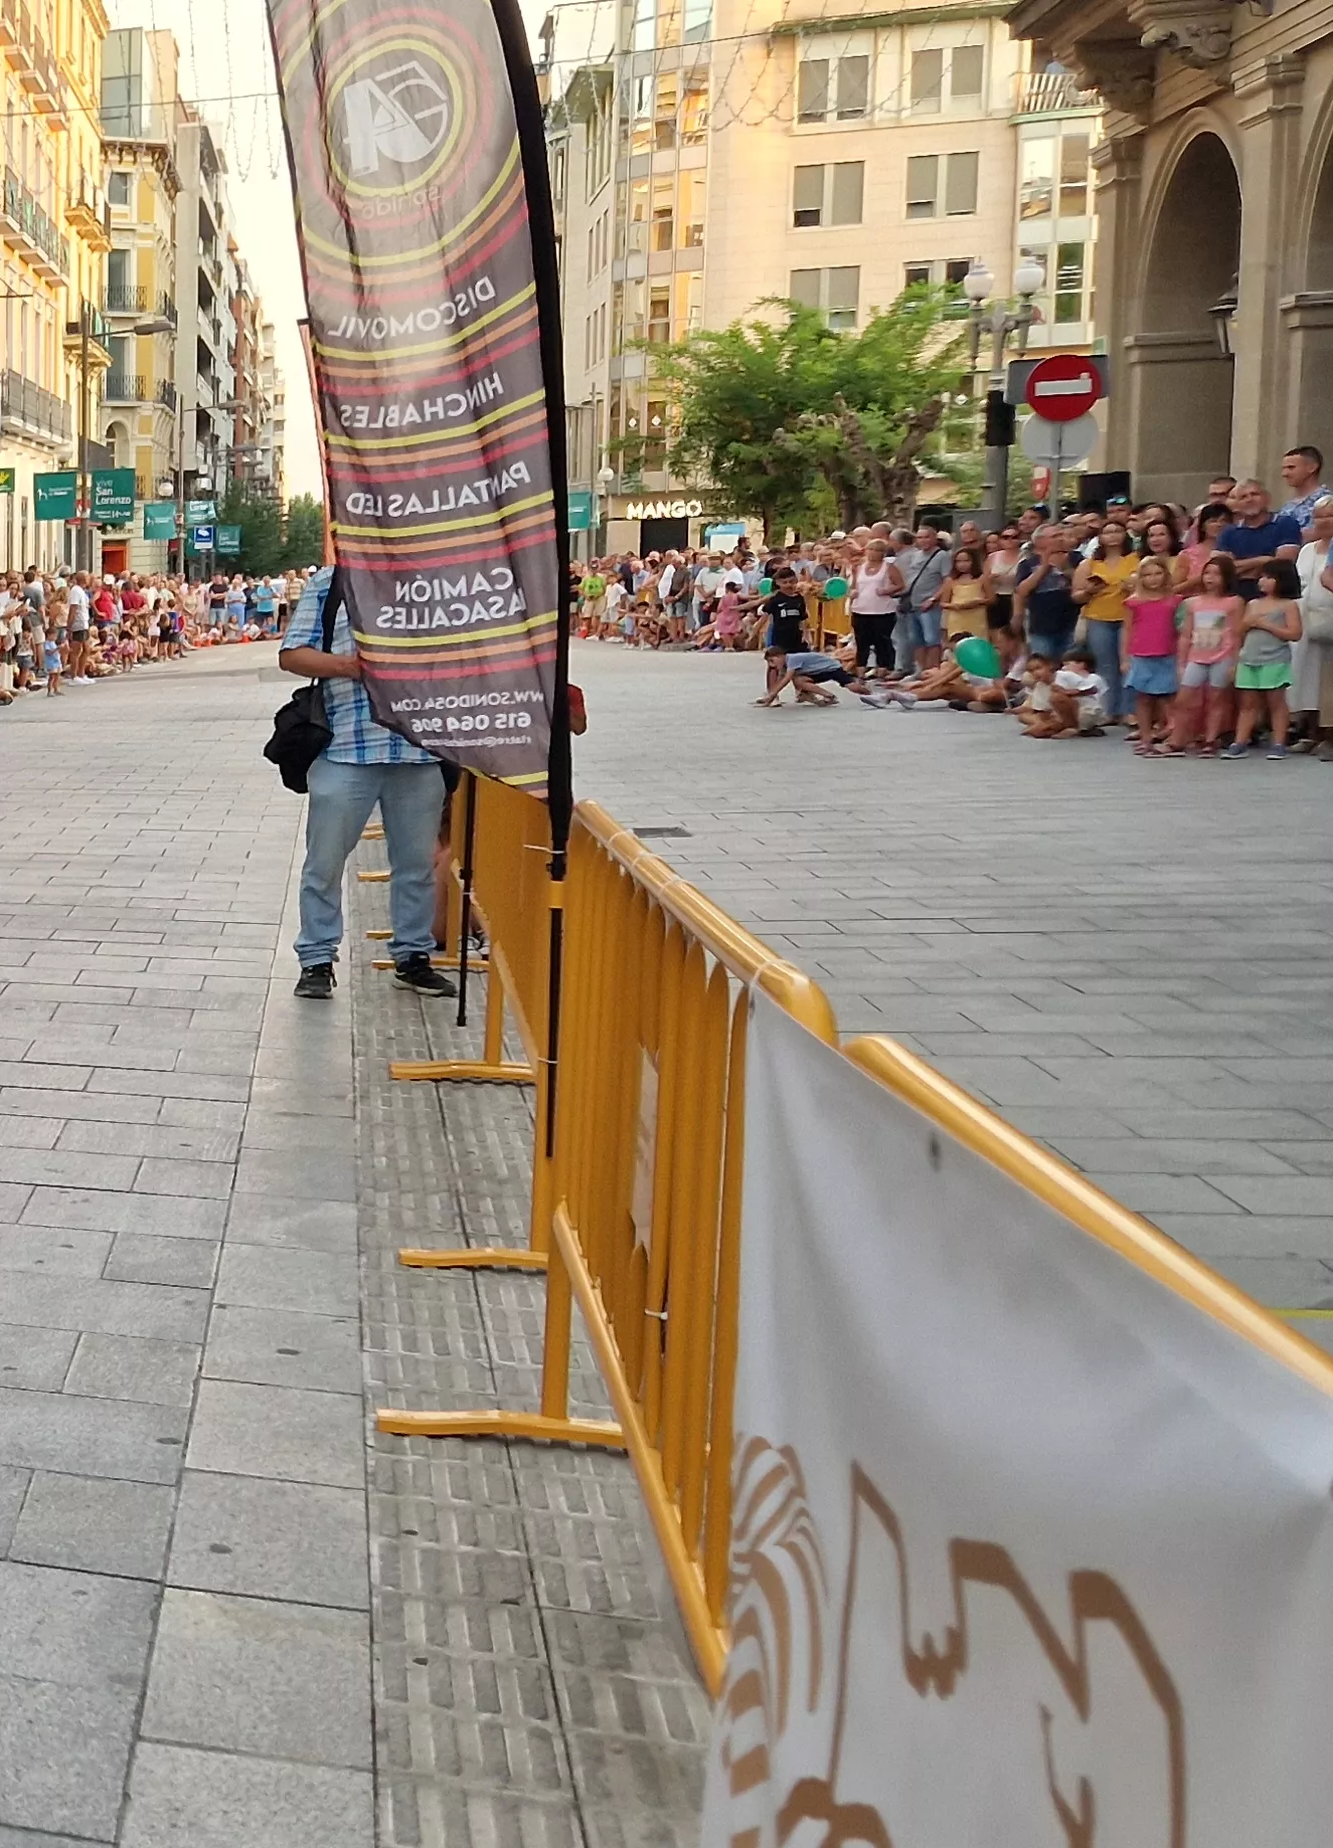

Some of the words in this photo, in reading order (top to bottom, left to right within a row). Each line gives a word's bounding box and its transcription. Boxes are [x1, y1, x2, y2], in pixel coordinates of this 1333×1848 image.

[96, 486, 113, 496] San
[96, 495, 132, 505] Lorenzo
[626, 500, 703, 520] MANGO
